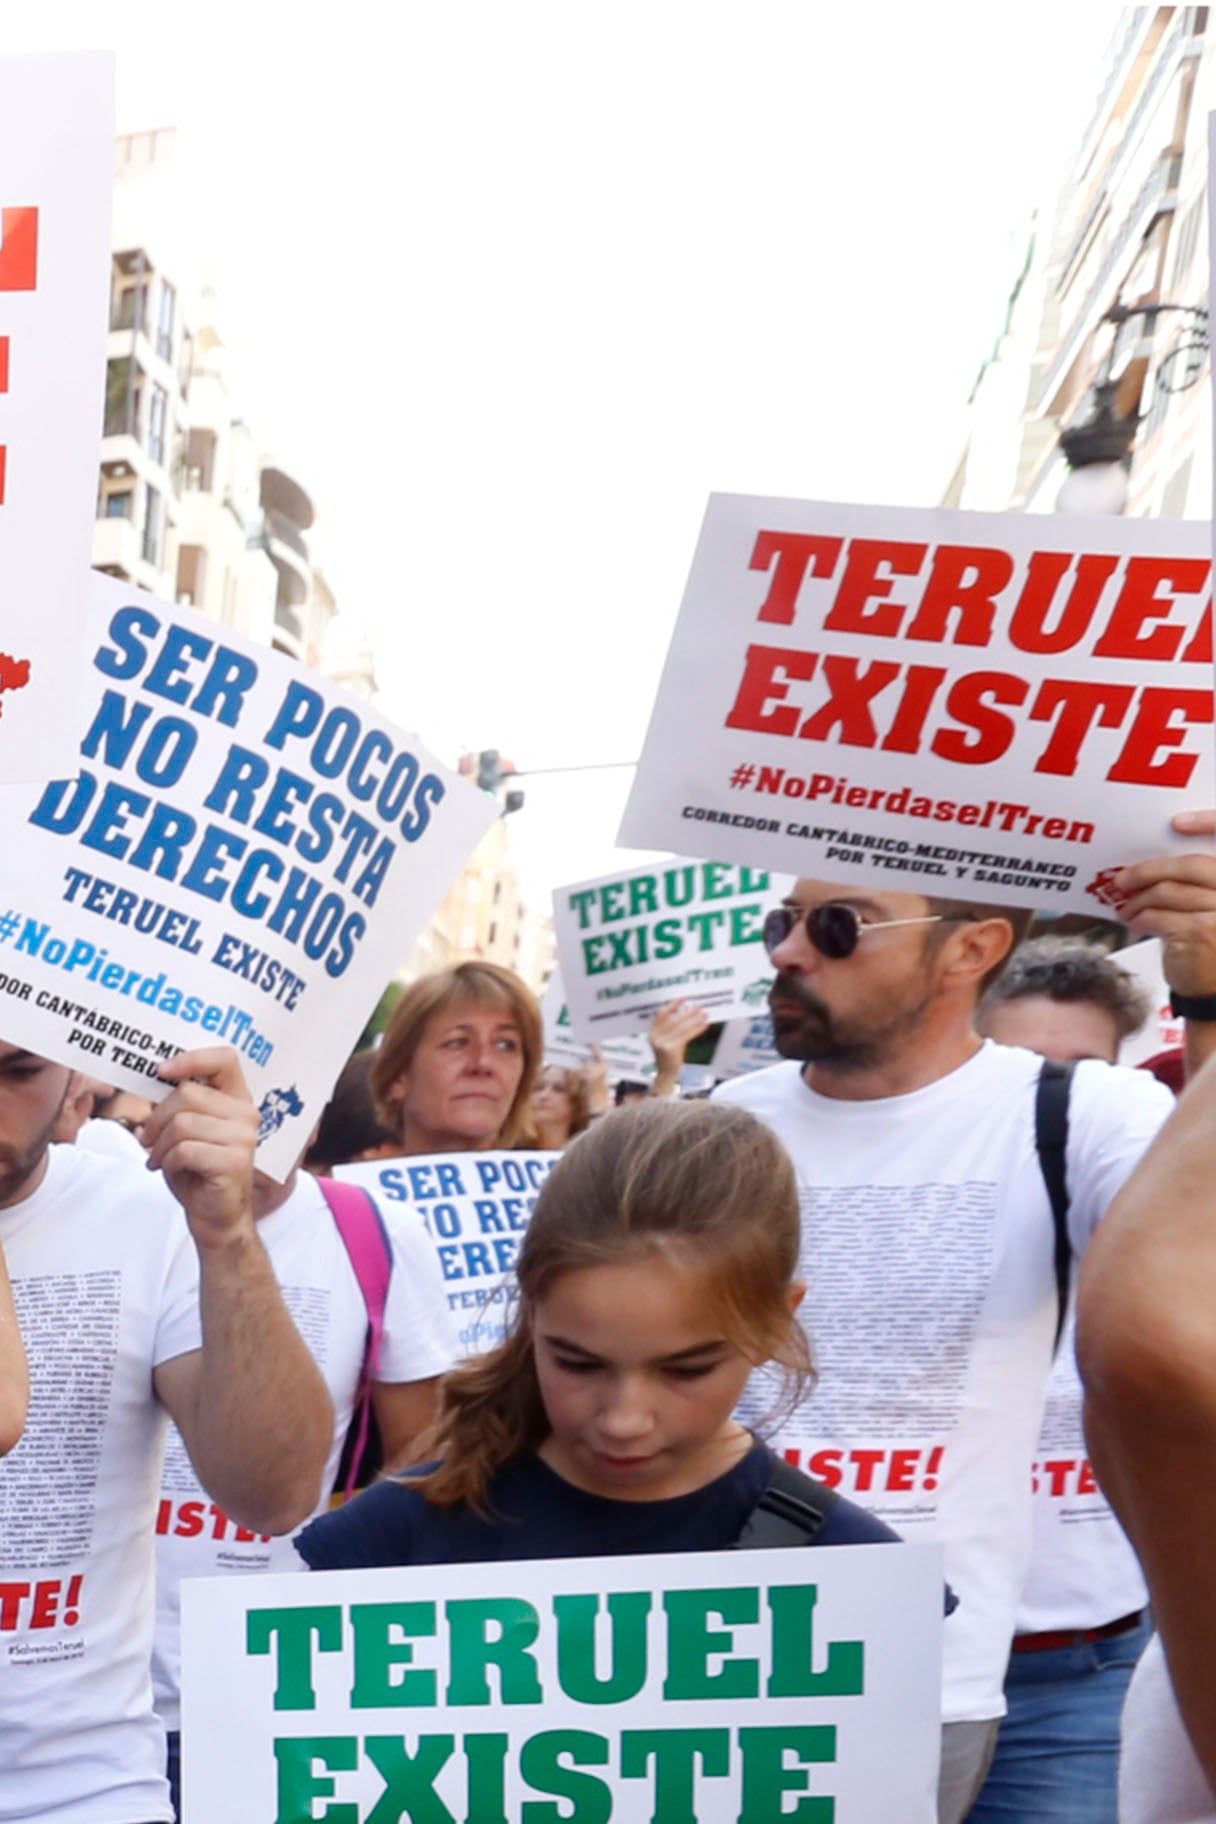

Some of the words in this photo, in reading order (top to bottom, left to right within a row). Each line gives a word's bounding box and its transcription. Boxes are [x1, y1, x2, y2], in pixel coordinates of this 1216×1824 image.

[92, 604, 259, 728] SER
[263, 678, 446, 843] POCOS
[725, 643, 1214, 789] EXISTE
[80, 688, 199, 789] NO
[203, 743, 396, 909] RESTA
[729, 762, 1096, 844] #NoPierdaselTren
[27, 767, 367, 979] DERECHOS
[682, 806, 780, 834] CORREDOR
[786, 822, 1078, 878] CANTÁBRICO-MEDITERRÁNEO
[825, 846, 864, 864] POR
[871, 852, 948, 877] TERUEL
[956, 866, 968, 879] Y
[974, 868, 1072, 893] SAGUNTO
[569, 861, 770, 930] TERUEL
[61, 866, 204, 955] TERUEL
[211, 933, 306, 1013] EXISTE
[581, 903, 765, 977] EXISTE
[67, 1028, 107, 1057] POR
[379, 1163, 466, 1202] SER
[246, 1583, 865, 1712] TERUEL
